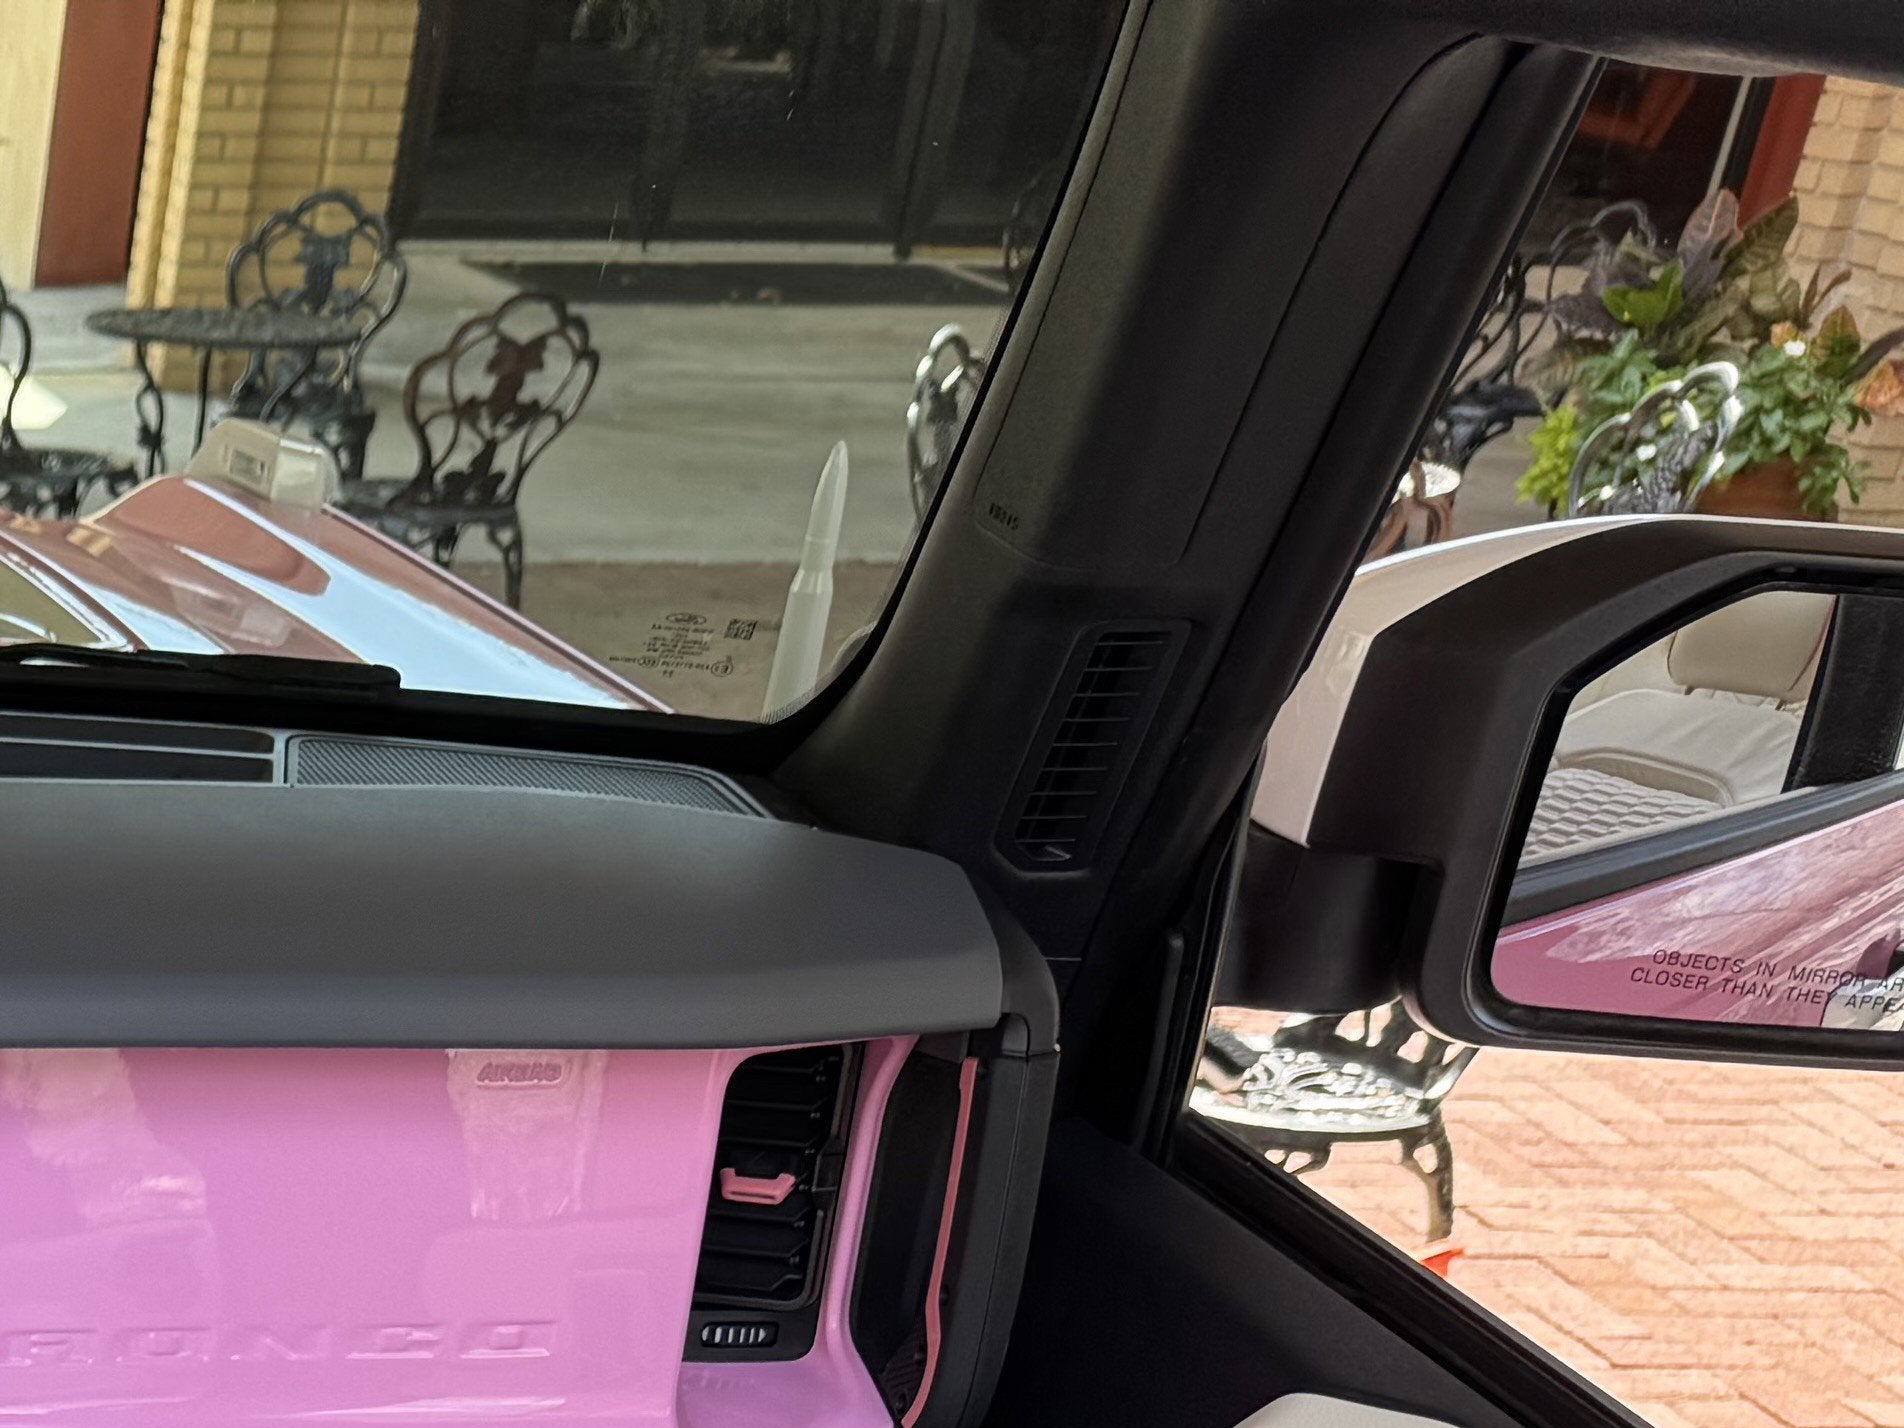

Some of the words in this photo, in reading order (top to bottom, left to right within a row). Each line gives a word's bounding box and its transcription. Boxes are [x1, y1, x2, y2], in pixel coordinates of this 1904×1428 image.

[1630, 967, 1710, 991] CLOSER
[1721, 979, 1775, 999] THAN
[1786, 986, 1837, 1005] THEY
[1652, 948, 1745, 974] OBJECTS
[1756, 961, 1776, 977] IN
[1789, 965, 1867, 987] MIRROR
